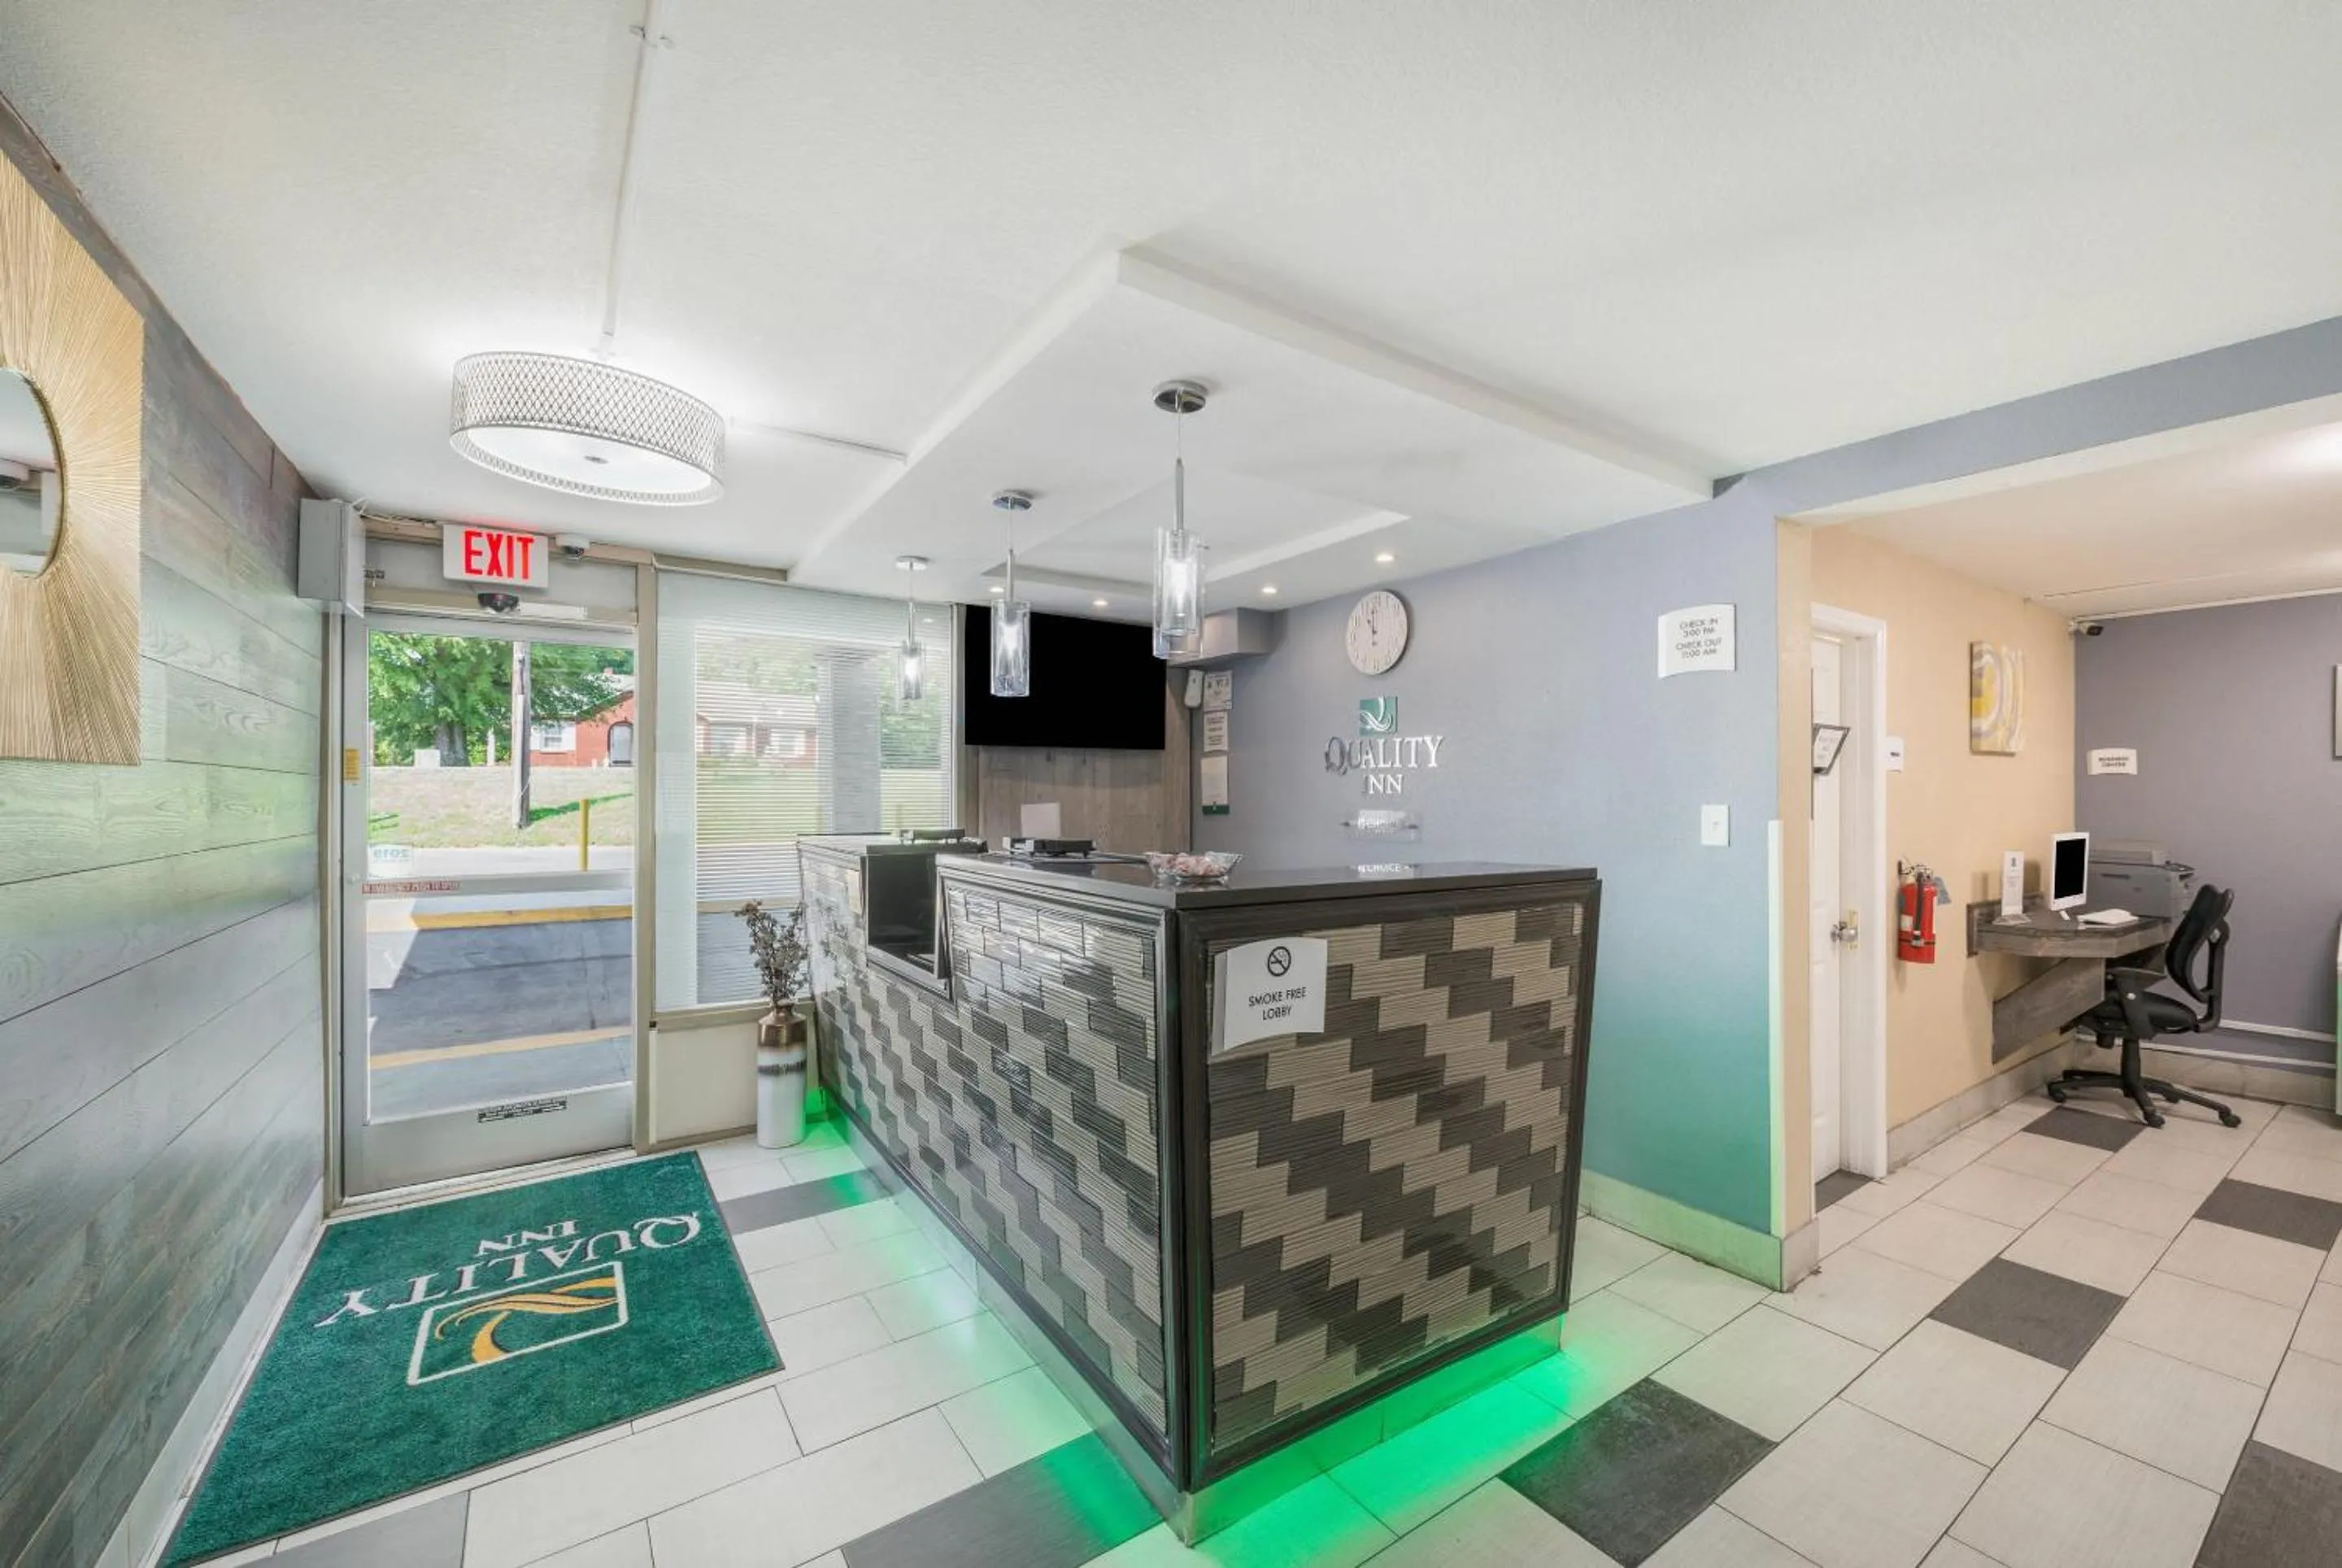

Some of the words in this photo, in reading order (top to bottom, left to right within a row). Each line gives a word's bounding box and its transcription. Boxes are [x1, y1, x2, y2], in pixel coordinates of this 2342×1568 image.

[464, 529, 534, 579] EXIT
[1324, 735, 1445, 775] QUALITY
[1248, 991, 1282, 1007] SMOKE
[1286, 986, 1307, 1000] FREE
[1262, 1006, 1292, 1021] LOBBY
[477, 1219, 581, 1257] INN
[314, 1212, 701, 1327] QUALITY
